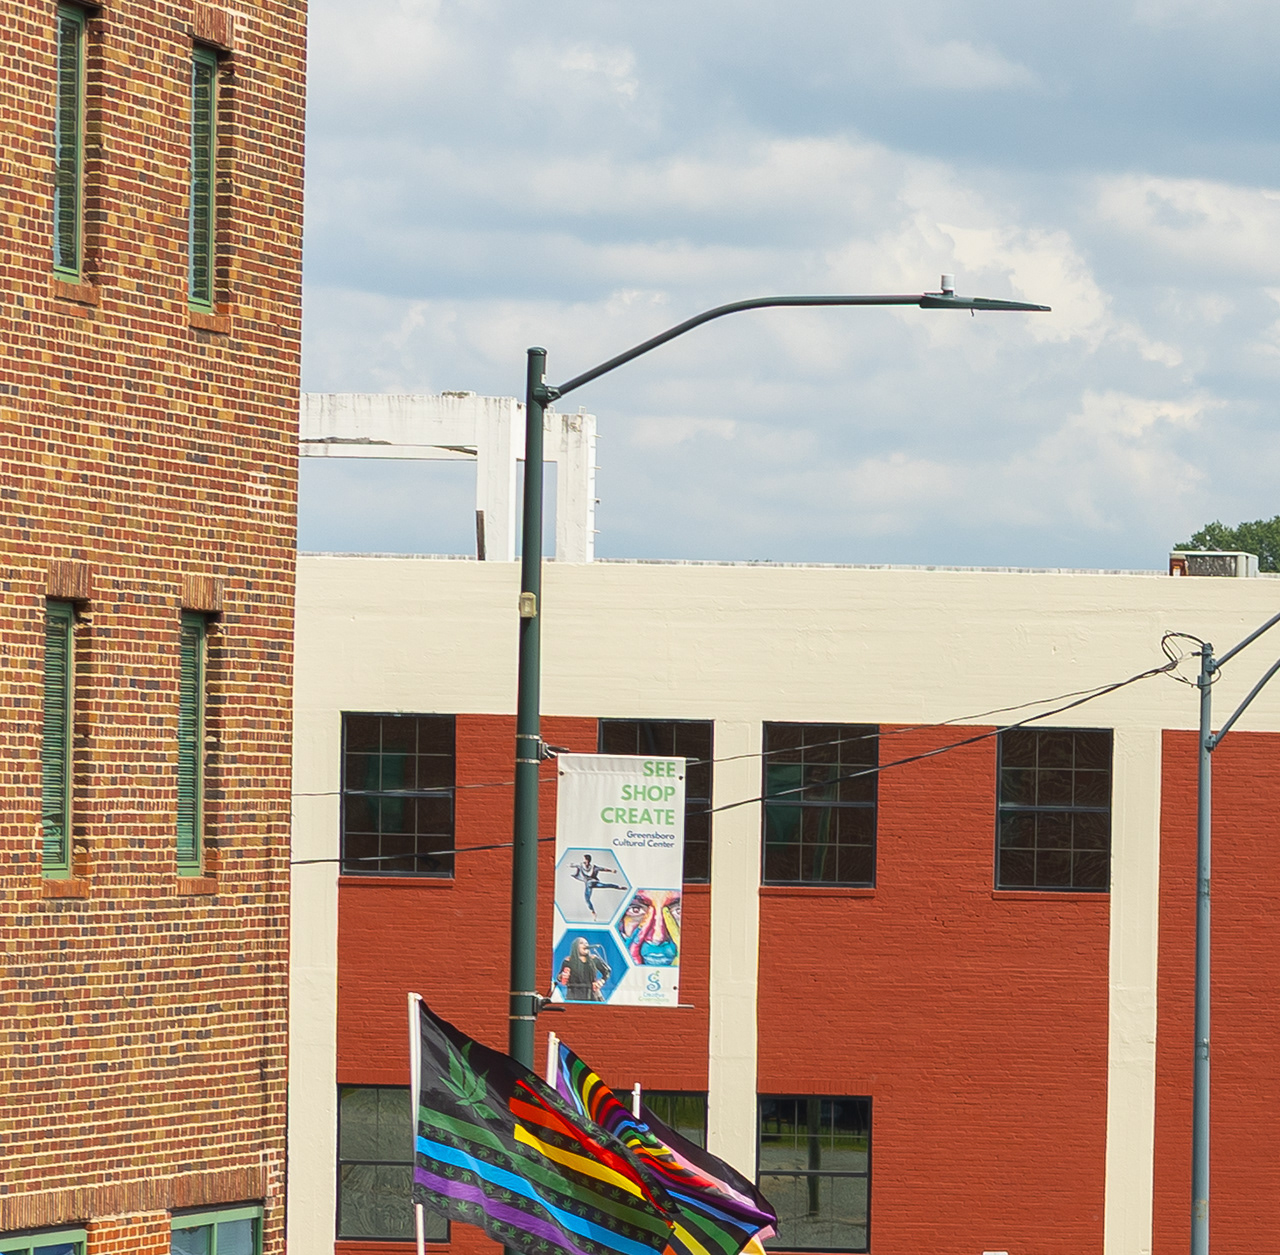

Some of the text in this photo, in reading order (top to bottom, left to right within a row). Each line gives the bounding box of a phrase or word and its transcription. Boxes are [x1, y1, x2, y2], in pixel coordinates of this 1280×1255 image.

[642, 761, 676, 777] SEE
[620, 784, 676, 801] SHOP
[600, 807, 675, 825] CREATE
[612, 838, 675, 848] Cultural Center
[626, 830, 675, 840] Greensboro
